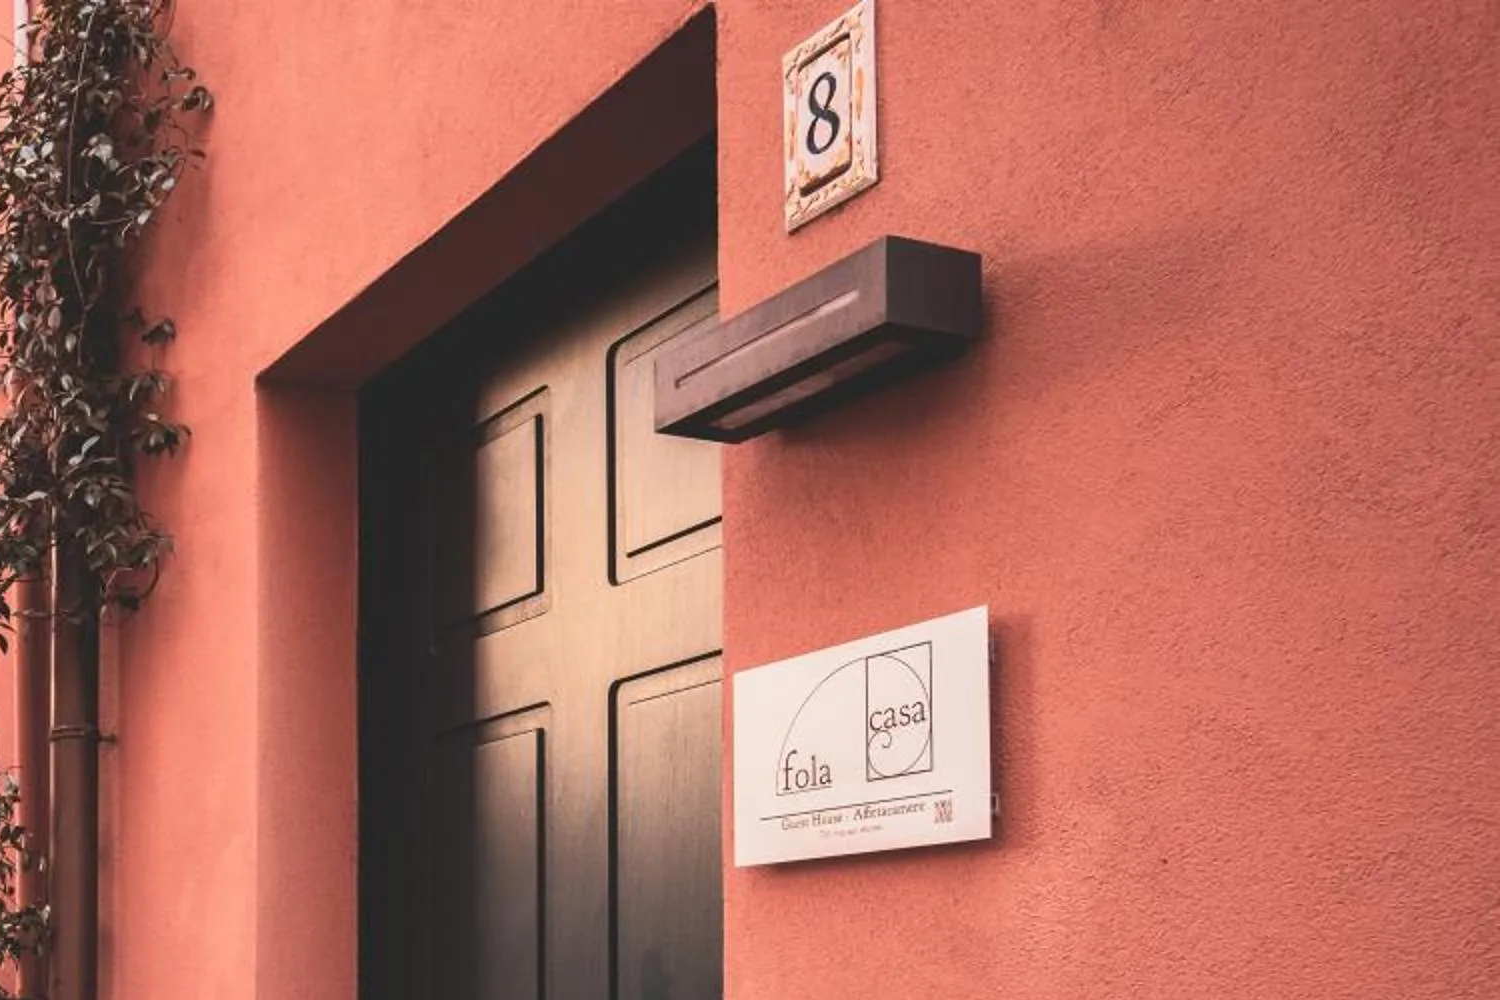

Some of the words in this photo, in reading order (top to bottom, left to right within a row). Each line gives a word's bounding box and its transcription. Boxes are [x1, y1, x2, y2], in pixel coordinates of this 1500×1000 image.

[806, 71, 840, 154] 8
[869, 700, 927, 732] casa
[782, 749, 832, 791] fola
